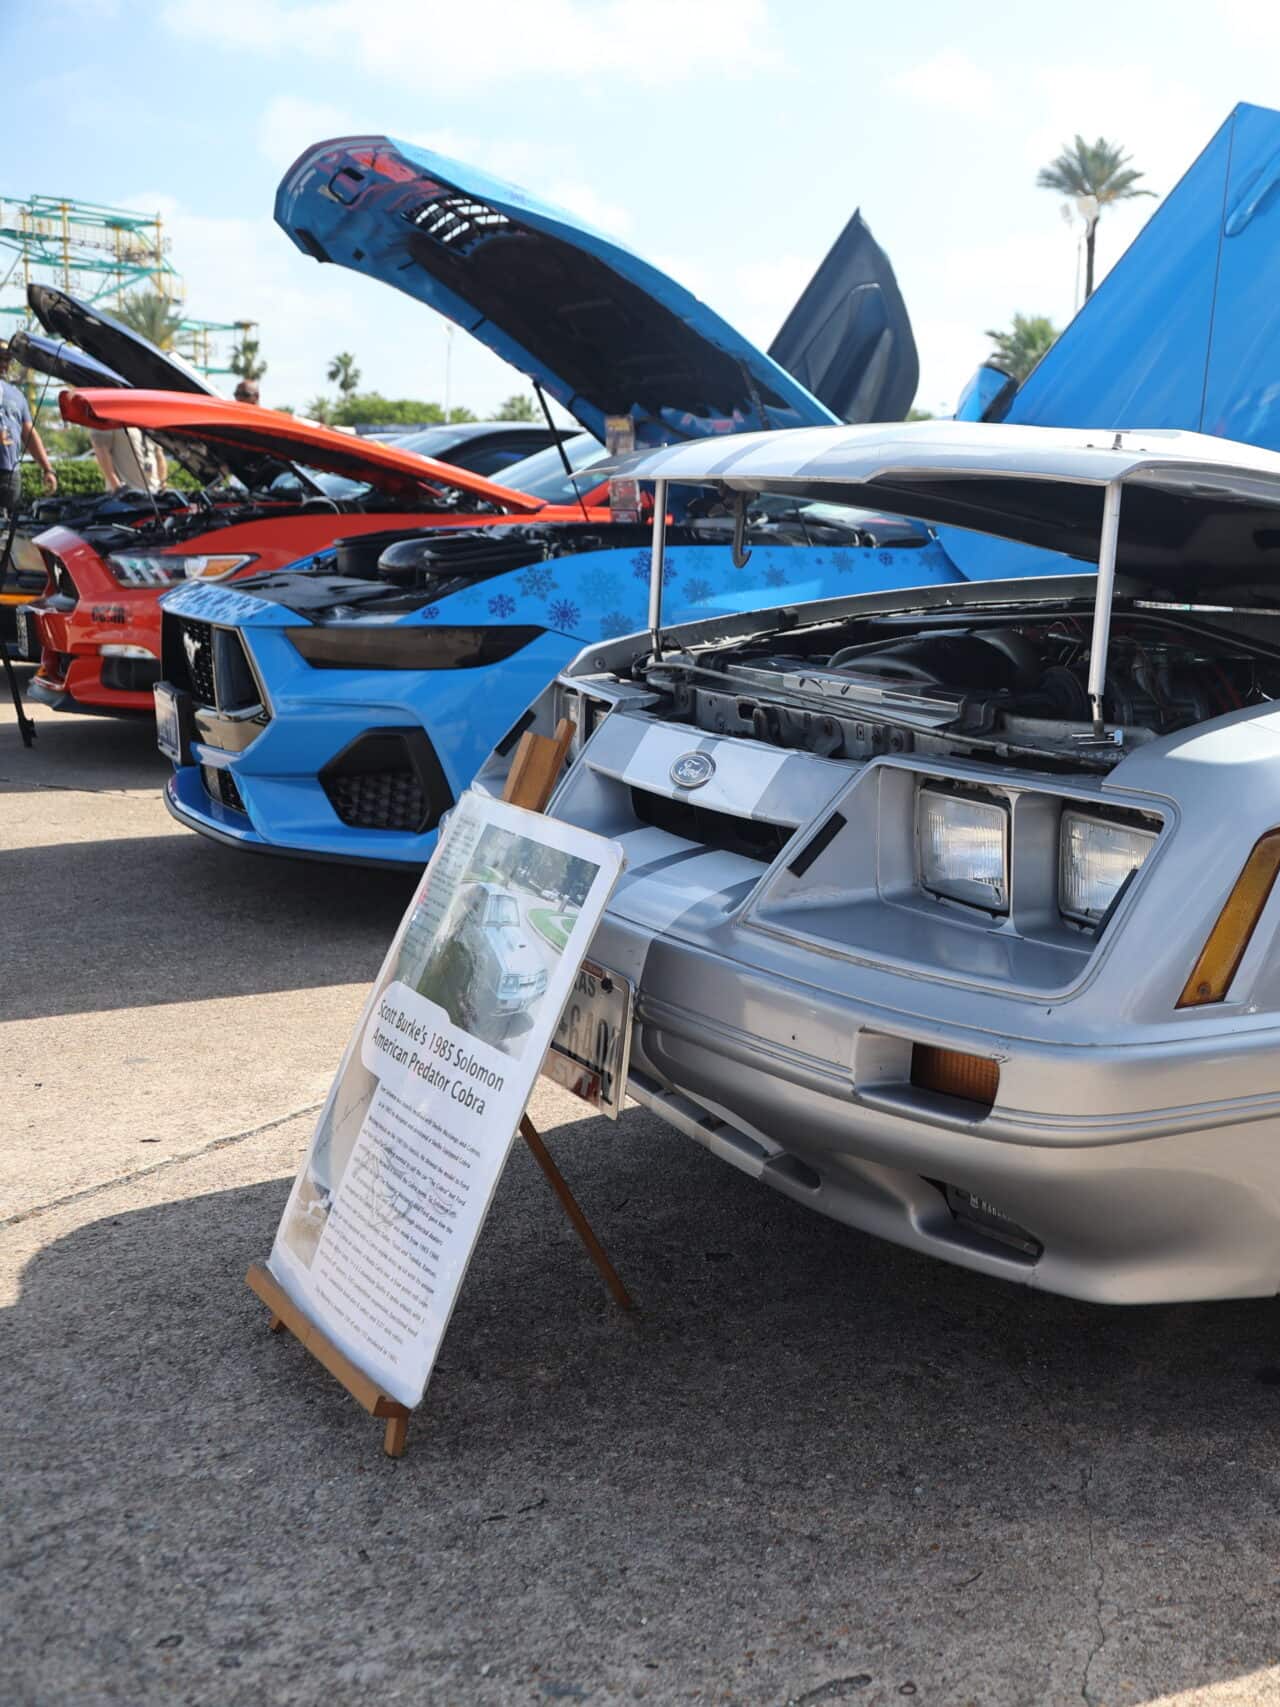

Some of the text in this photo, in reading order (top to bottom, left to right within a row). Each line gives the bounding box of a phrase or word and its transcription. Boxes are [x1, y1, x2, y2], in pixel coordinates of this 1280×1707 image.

[371, 1027, 487, 1116] American Predator Cobra
[377, 999, 505, 1092] Scott Burke's 1985 Solomon
